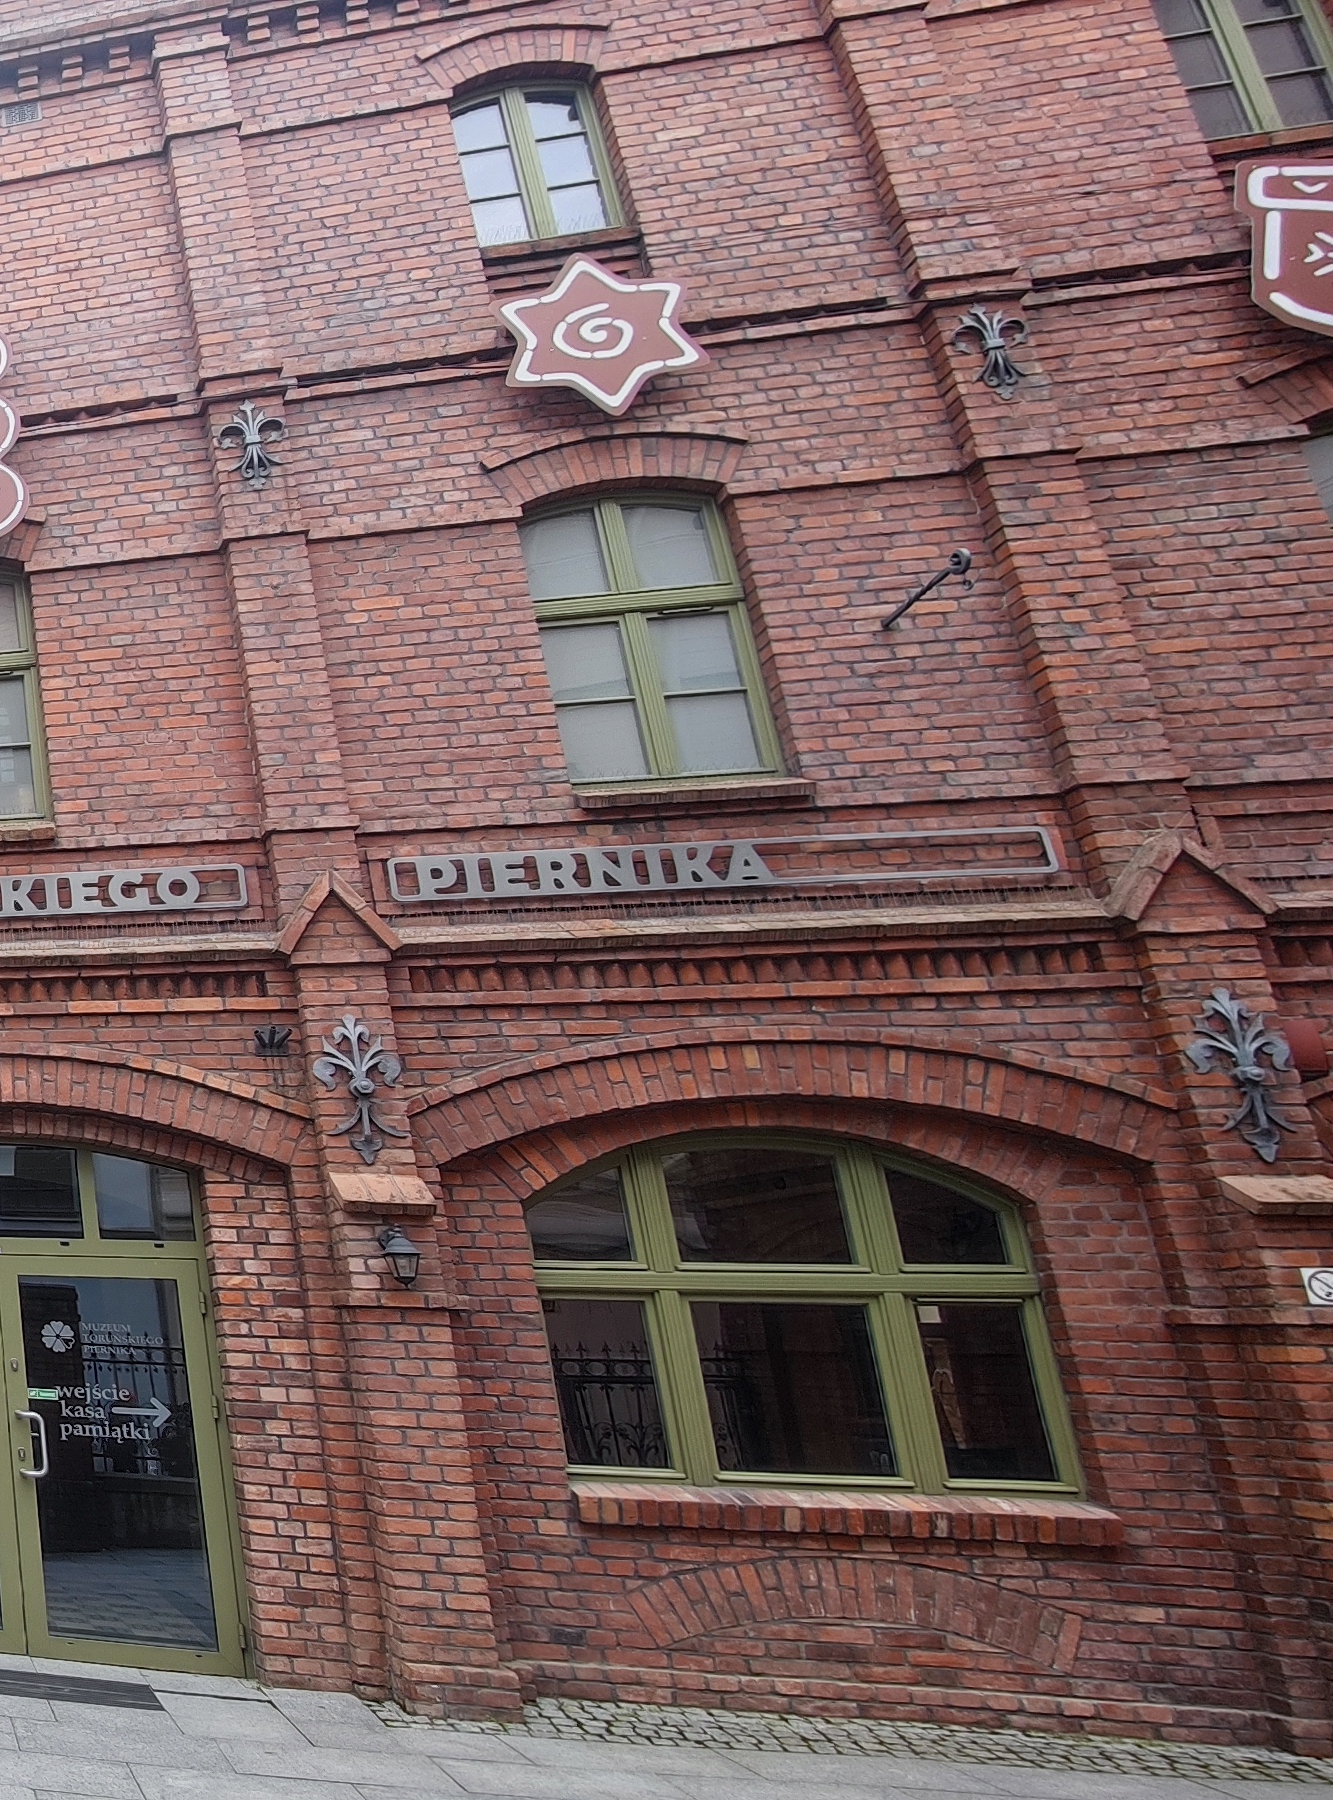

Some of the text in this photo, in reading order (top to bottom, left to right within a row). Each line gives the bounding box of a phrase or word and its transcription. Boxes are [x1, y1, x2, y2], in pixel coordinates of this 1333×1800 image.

[415, 844, 774, 896] PIERNIKA
[81, 1322, 131, 1332] MUZEUM
[84, 1346, 137, 1355] PIERNIKA
[55, 1383, 131, 1404] wejście
[58, 1400, 106, 1419] kasa
[59, 1421, 151, 1444] pamiątki
